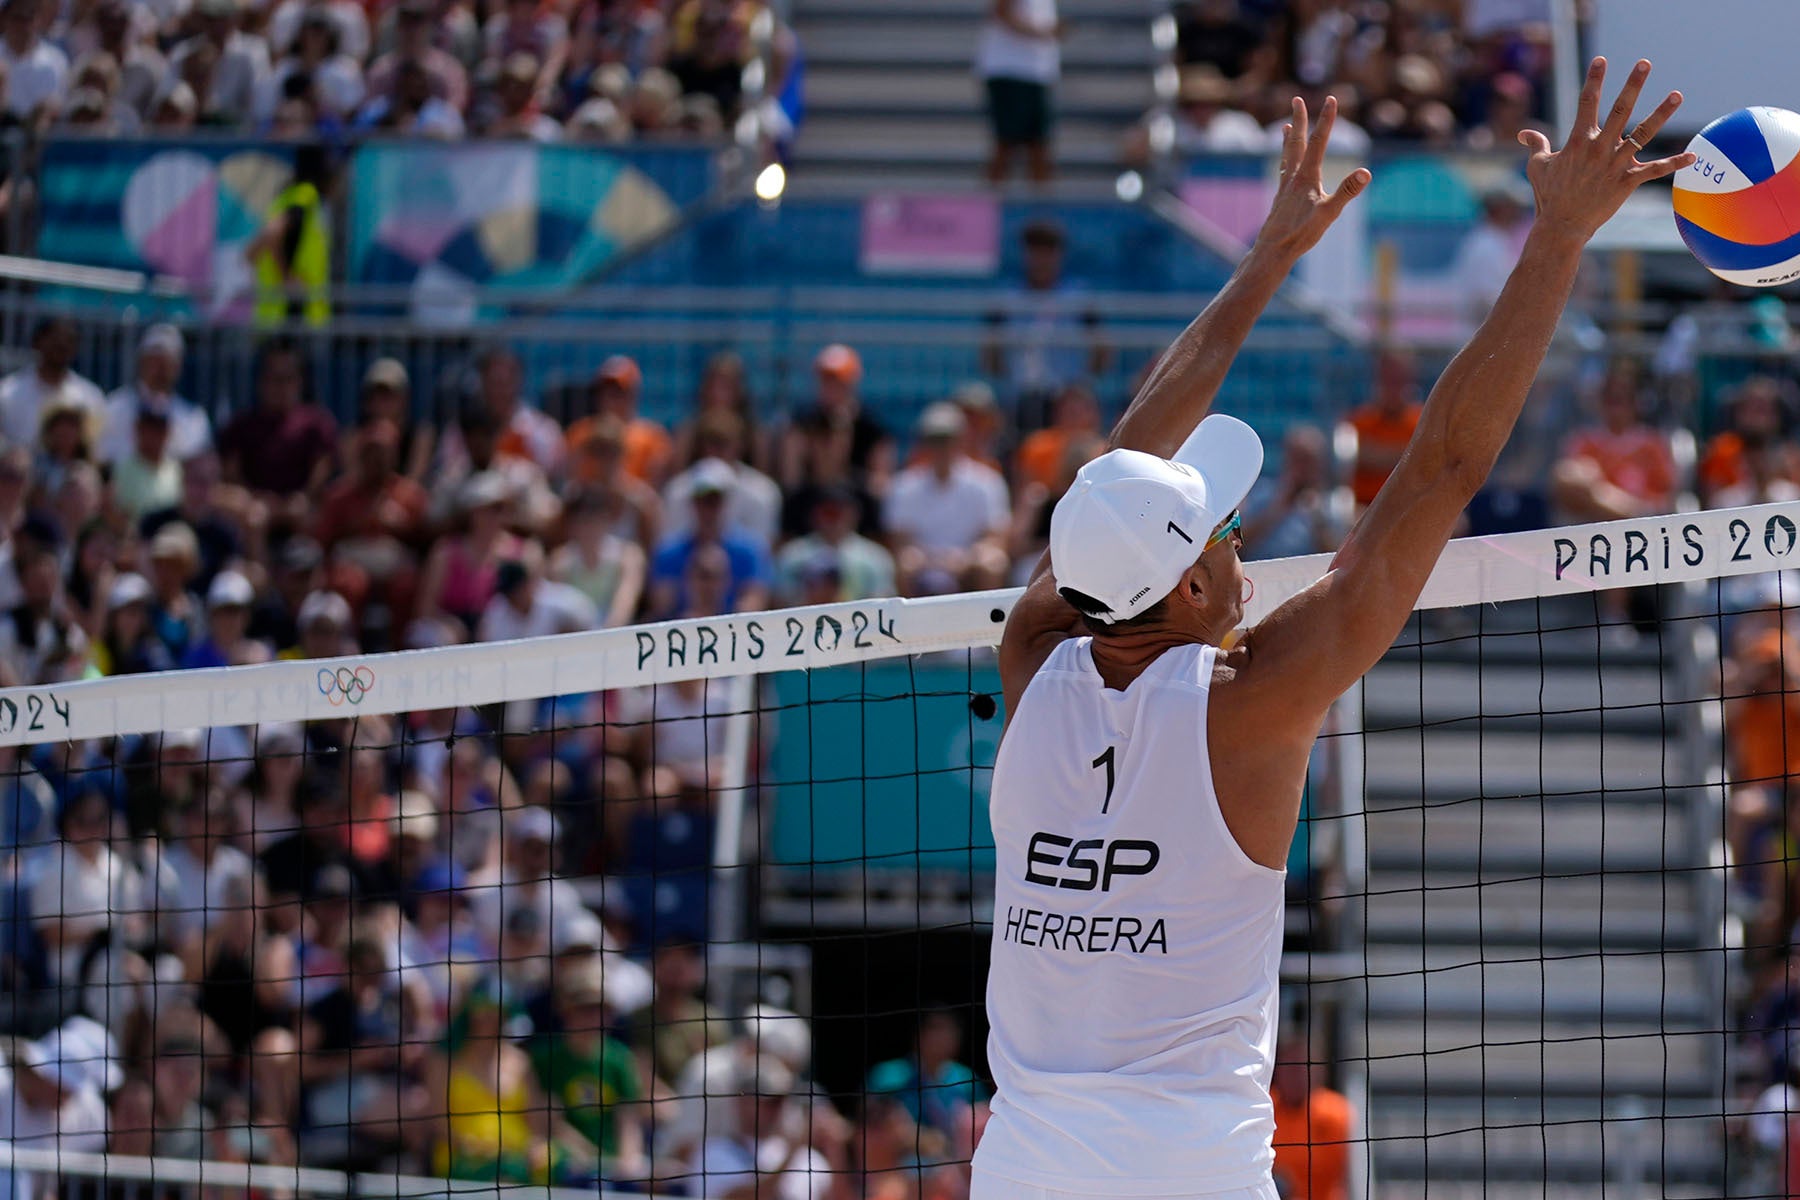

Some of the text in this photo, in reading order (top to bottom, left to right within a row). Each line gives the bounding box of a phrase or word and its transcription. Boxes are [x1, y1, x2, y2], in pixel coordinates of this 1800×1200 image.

[1167, 520, 1193, 544] 1
[785, 609, 901, 652] 2024
[1092, 746, 1115, 814] 1
[1025, 832, 1160, 892] ESP
[1004, 906, 1168, 954] HERRERA
